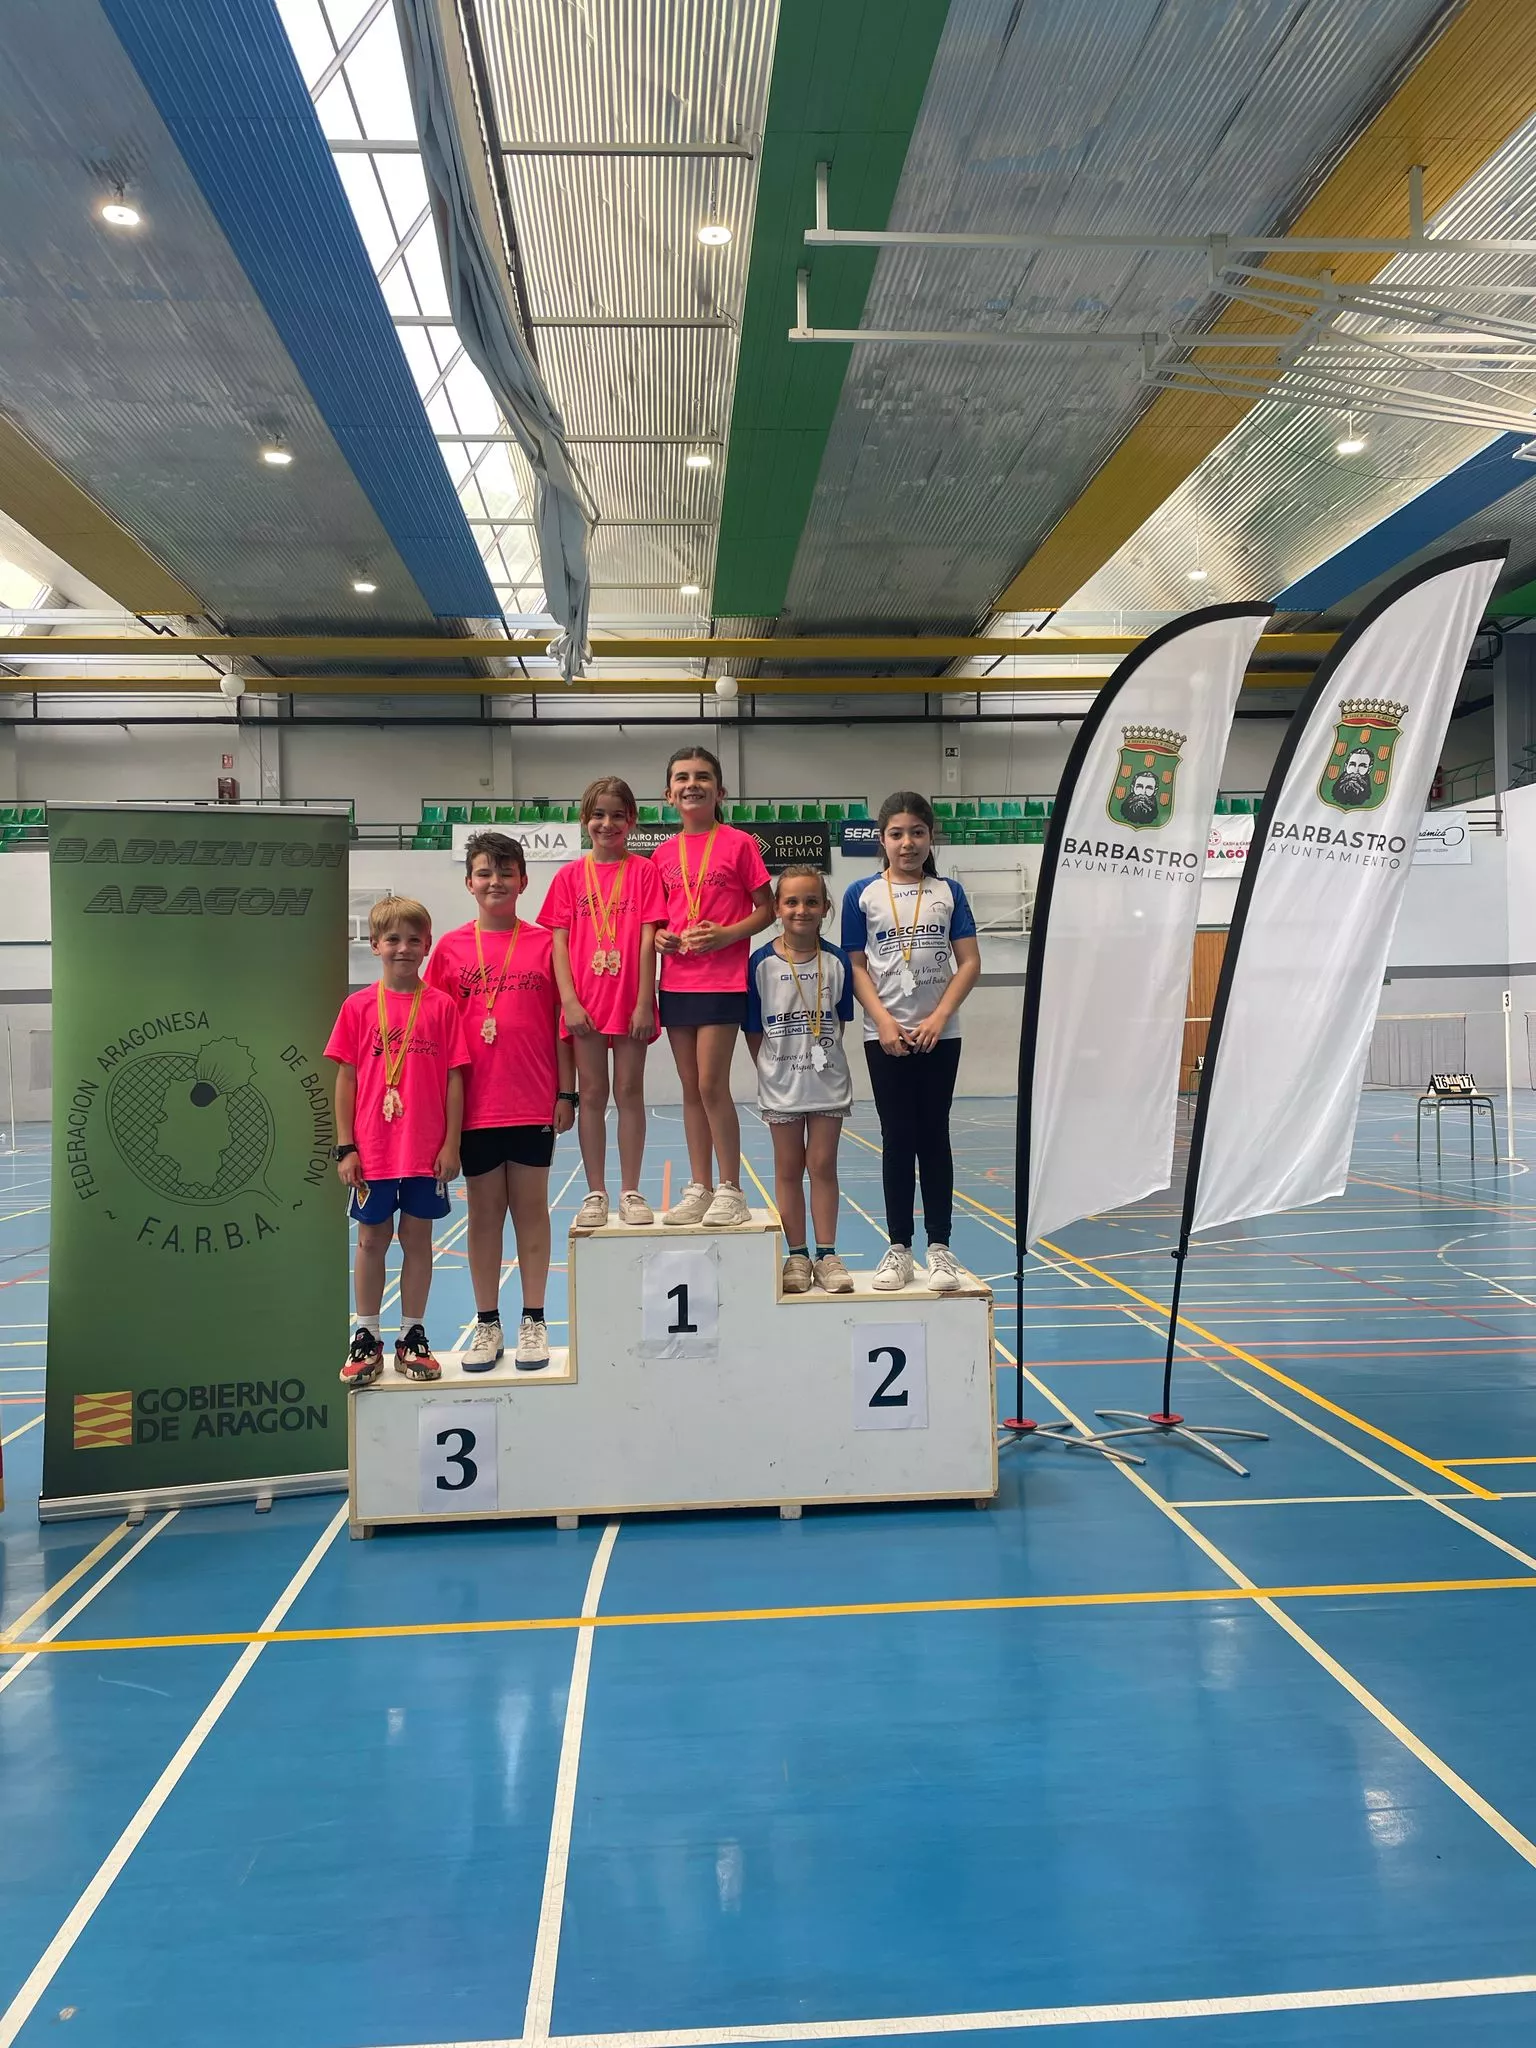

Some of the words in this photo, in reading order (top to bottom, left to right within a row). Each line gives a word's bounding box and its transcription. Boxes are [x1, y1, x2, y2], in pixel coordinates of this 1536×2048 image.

[627, 833, 652, 841] JAIRO
[654, 833, 677, 841] RON
[775, 836, 823, 846] GRUPO
[1271, 821, 1406, 854] BARBASTRO
[52, 838, 347, 868] BADMINTON
[775, 847, 823, 857] IREMAR
[1063, 837, 1198, 869] BARBASTRO
[1207, 846, 1249, 859] RAGÓ
[1267, 843, 1401, 869] AYUNTAMIENTO
[1061, 857, 1196, 883] AYUNTAMIENTO
[84, 885, 313, 916] ARAGON
[888, 924, 939, 937] GECRIO
[902, 940, 918, 948] LNG
[1504, 993, 1510, 1007] 3
[776, 1010, 825, 1022] GECRIO
[1436, 1077, 1448, 1088] 16
[1460, 1076, 1471, 1087] 17
[67, 1079, 100, 1201] FEDERACION
[97, 1010, 210, 1073] ARAGONESA
[280, 1044, 308, 1072] DE
[300, 1072, 333, 1187] BADMINTON
[667, 1284, 698, 1334] 1
[868, 1346, 910, 1408] 2
[137, 1378, 305, 1415] GOBIERNO
[137, 1416, 179, 1444] DE
[191, 1404, 328, 1440] ARAGON
[435, 1428, 478, 1491] 3
